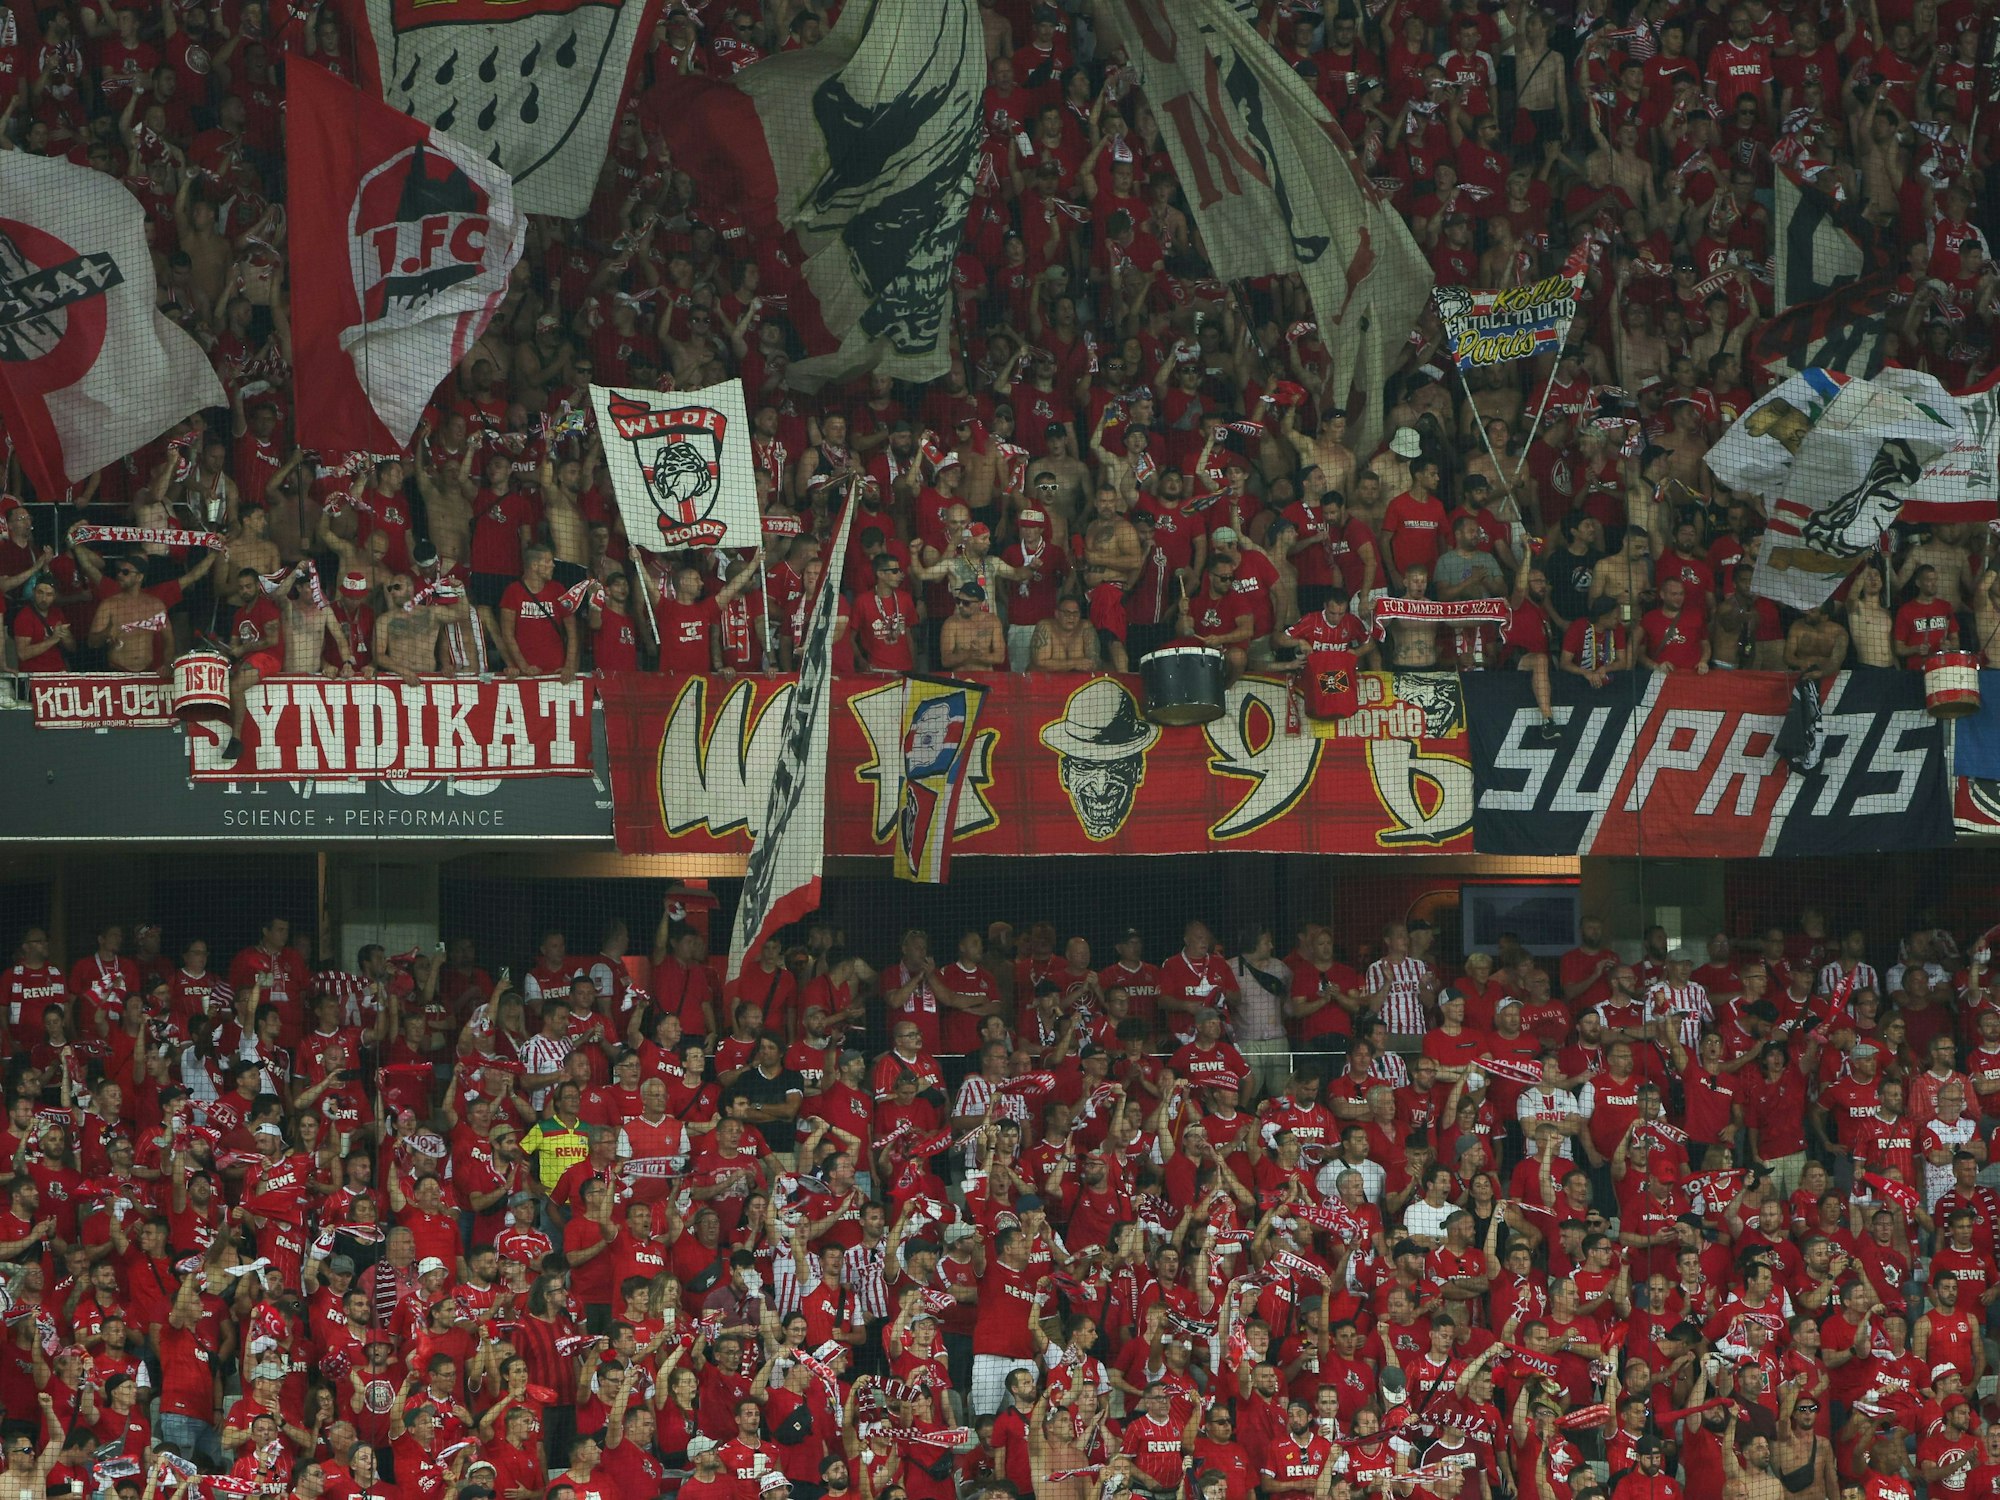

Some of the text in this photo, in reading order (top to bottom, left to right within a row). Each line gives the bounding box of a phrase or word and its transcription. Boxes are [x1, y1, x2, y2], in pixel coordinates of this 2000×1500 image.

[1729, 65, 1761, 76] REWE
[373, 213, 489, 279] 1.FC
[1490, 275, 1576, 314] Kölle
[1457, 327, 1537, 367] Paris
[619, 410, 721, 440] WILDE
[511, 461, 536, 472] EWE
[100, 528, 206, 547] SYNDIKAT
[666, 522, 724, 544] HORDE
[1383, 598, 1405, 613] FÜR
[1407, 601, 1445, 615] IMMER
[1471, 600, 1500, 615] KÖLN
[1313, 640, 1349, 651] REWE
[385, 768, 410, 778] 2007
[223, 809, 315, 827] SCIENCE
[345, 809, 505, 827] PERFORMANCE
[184, 986, 211, 995] REW
[656, 1062, 684, 1077] REW
[1190, 1061, 1226, 1073] REWE
[800, 1069, 824, 1080] REW
[336, 1109, 359, 1121] EWE
[1878, 1138, 1912, 1150] REWE
[555, 1146, 588, 1158] REWE
[1148, 1441, 1182, 1452] REWE
[1286, 1464, 1320, 1477] REWE
[262, 1482, 288, 1494] EWE
